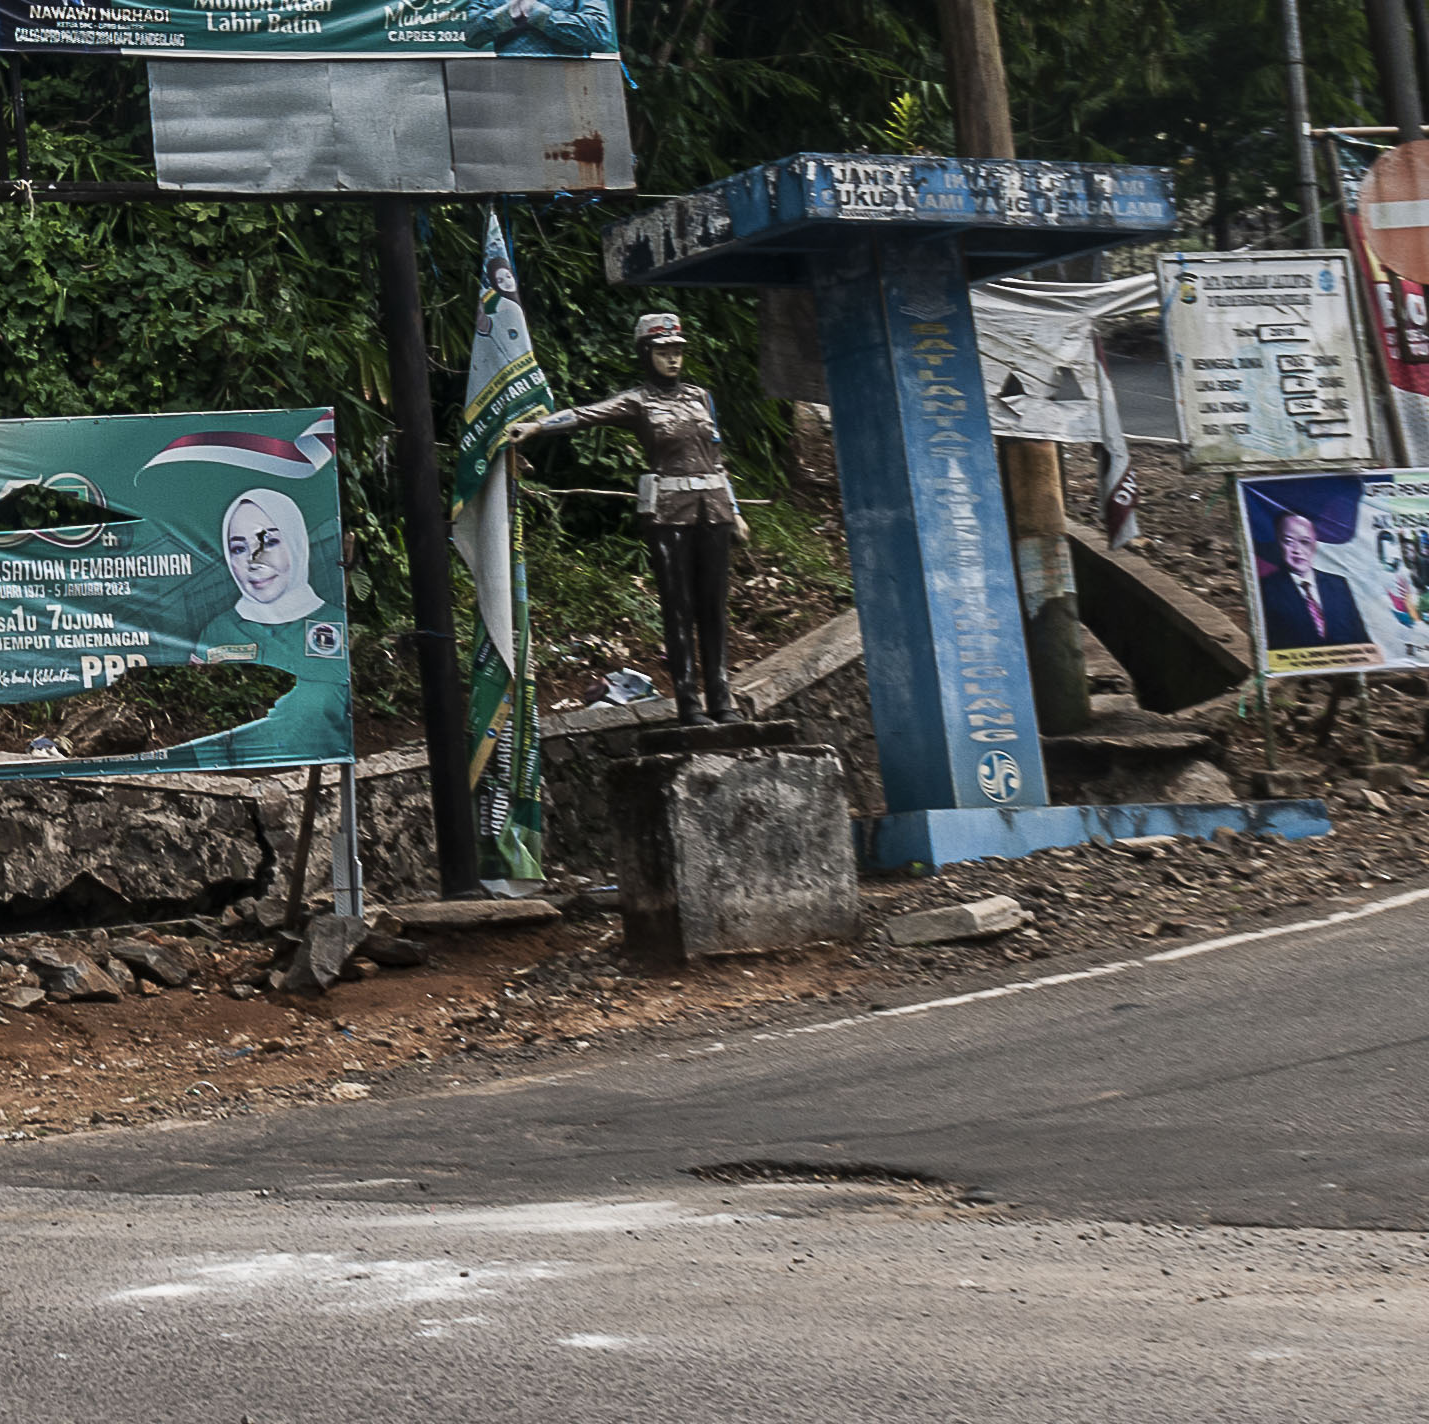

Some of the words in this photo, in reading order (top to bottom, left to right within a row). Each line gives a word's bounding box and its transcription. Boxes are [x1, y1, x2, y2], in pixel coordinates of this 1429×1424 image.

[29, 5, 96, 21] NAWAWI
[99, 7, 172, 23] NURHADI
[206, 12, 262, 32] Lahir
[267, 13, 323, 34] Batin
[388, 30, 437, 42] CAPRES
[438, 30, 466, 42] 2024
[69, 553, 193, 581] PEMBANGUNAN
[23, 584, 46, 598] 1973
[54, 586, 61, 597] 5
[63, 583, 104, 597] JANUARI
[104, 581, 132, 596] 2023
[55, 632, 150, 648] KEMENANGAN
